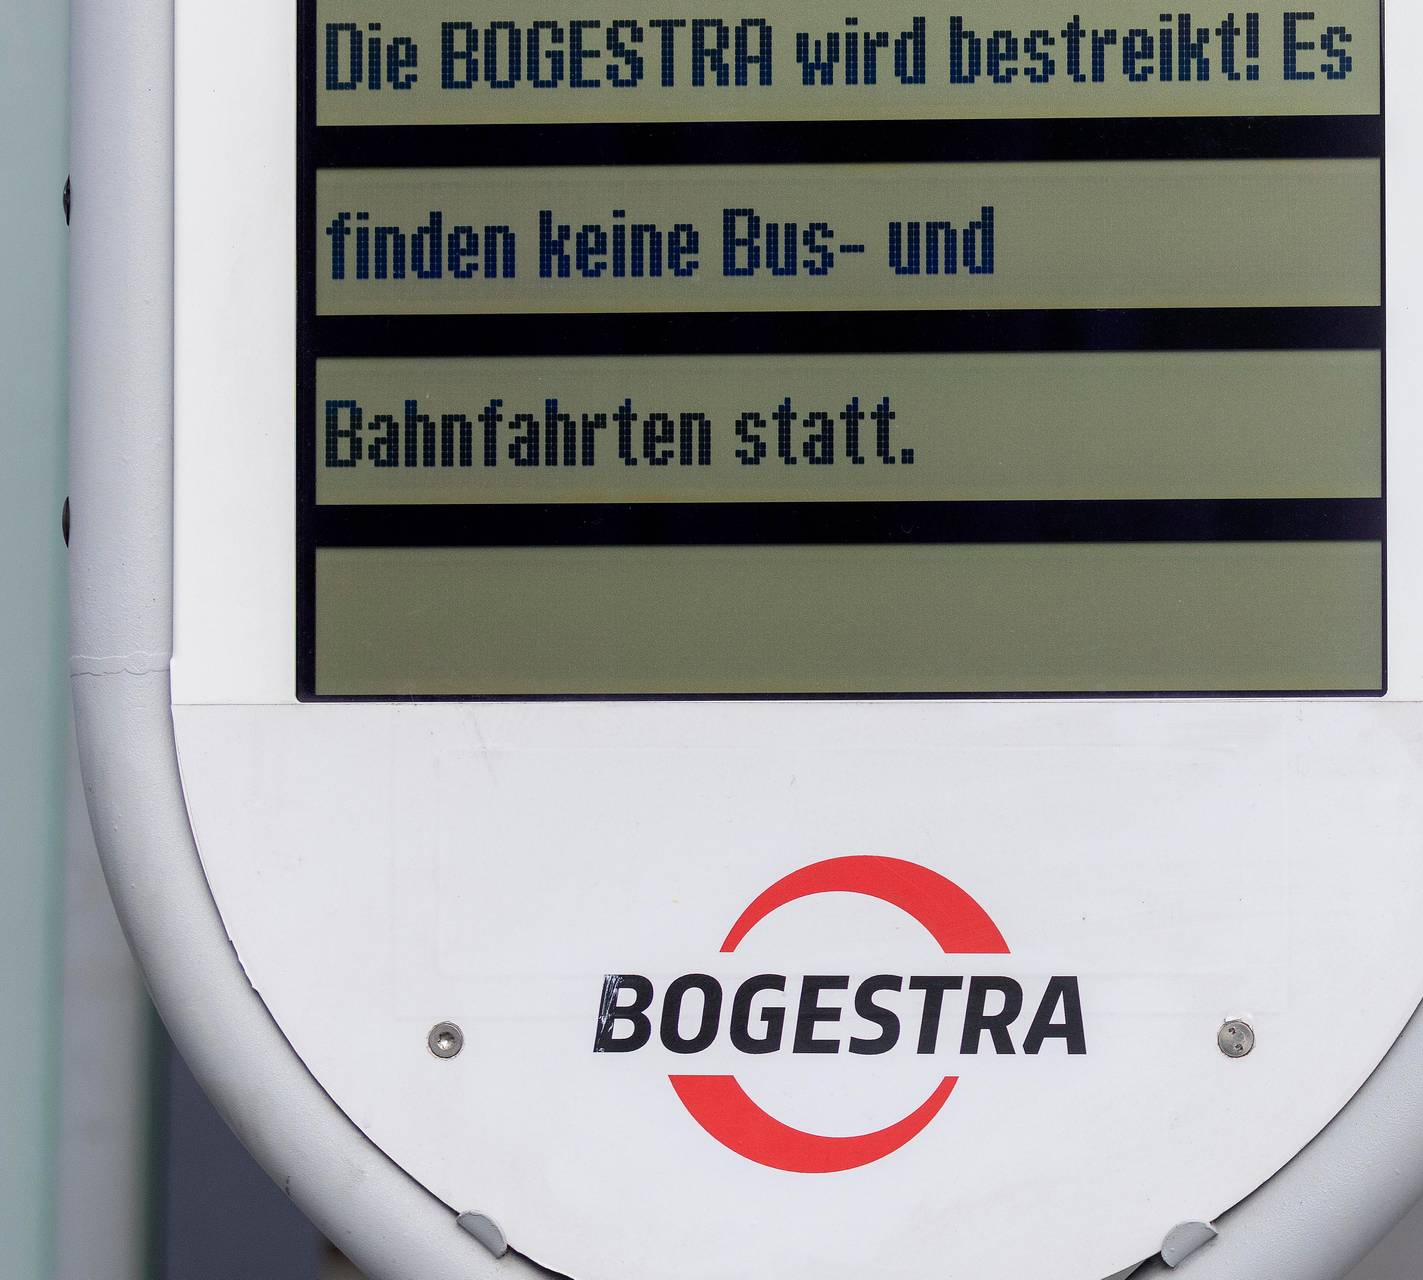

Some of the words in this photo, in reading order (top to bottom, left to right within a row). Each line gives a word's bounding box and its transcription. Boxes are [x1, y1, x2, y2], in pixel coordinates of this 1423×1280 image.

[326, 22, 418, 91] Die
[441, 17, 773, 90] BOGESTRA
[796, 16, 926, 86] wird
[949, 12, 1259, 85] bestreikt!
[1283, 11, 1353, 81] Es
[326, 210, 516, 281] finden
[538, 209, 700, 279] keine
[722, 207, 865, 277] Bus-
[888, 205, 995, 276] und
[324, 397, 712, 469] Bahnfahrten
[734, 396, 915, 466] statt.
[593, 973, 1088, 1056] BOGESTRA
